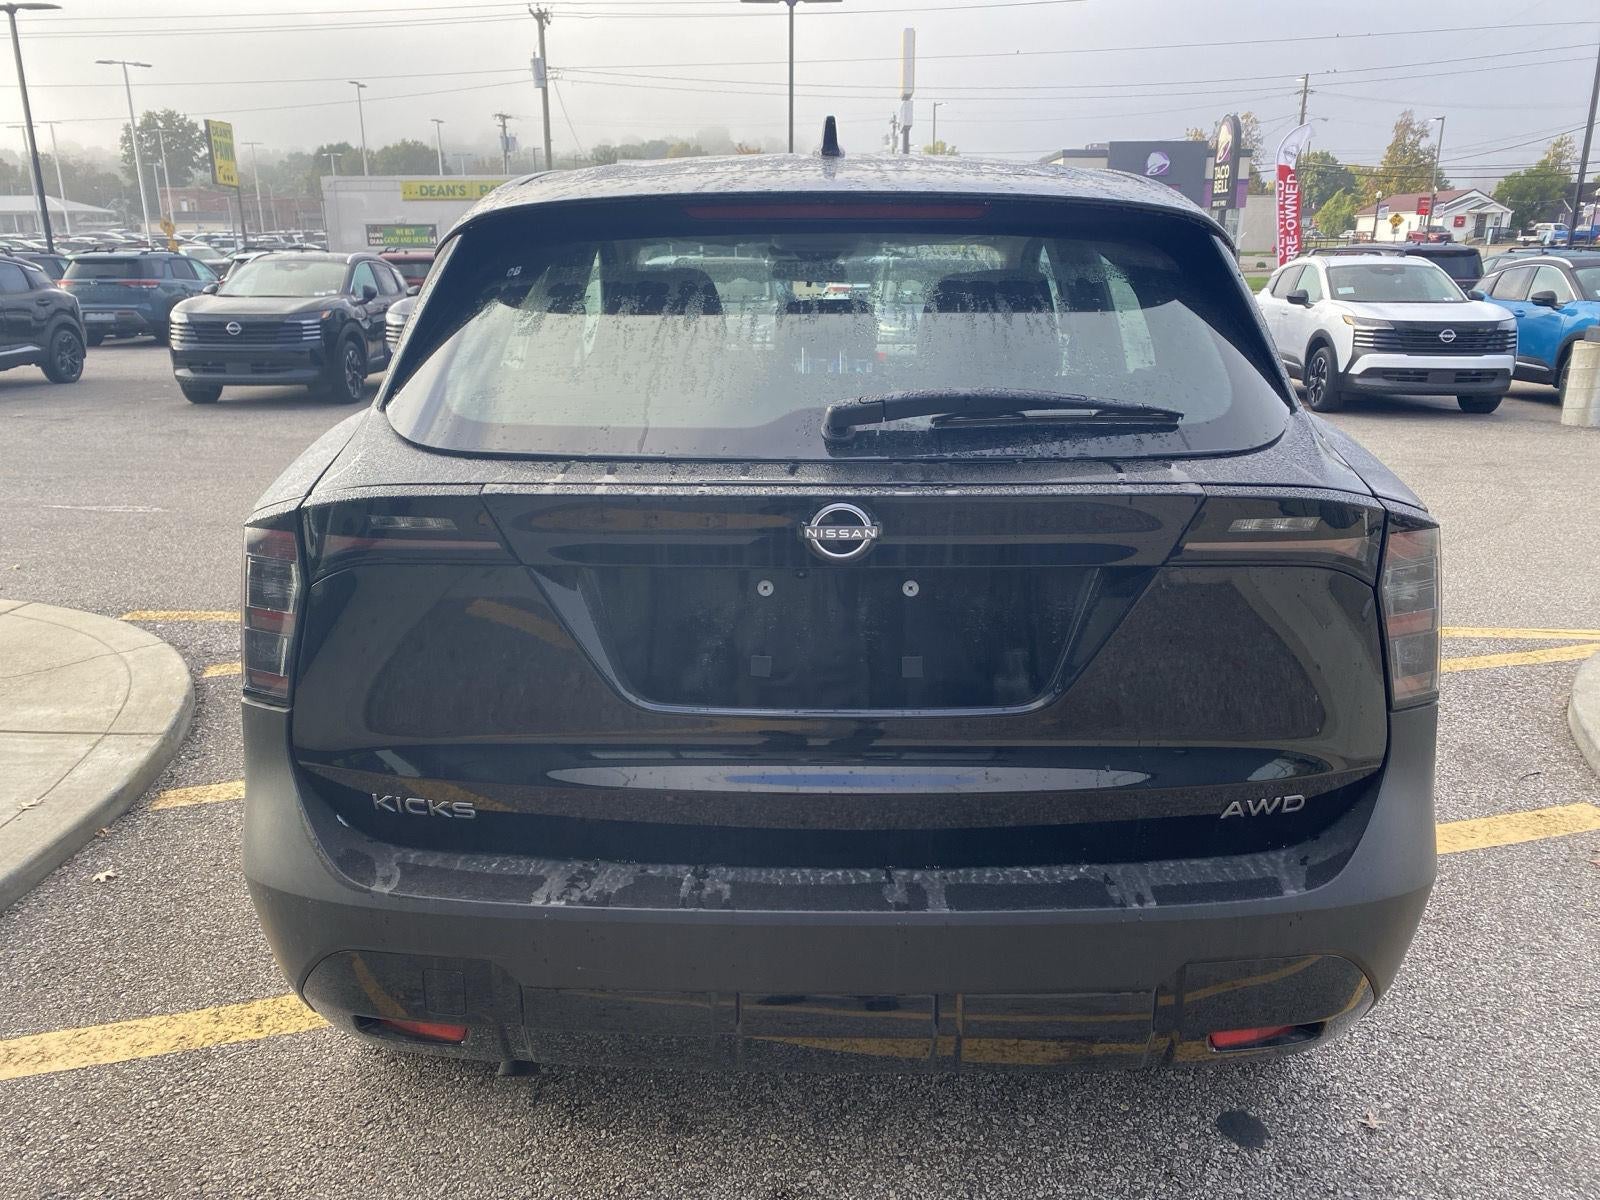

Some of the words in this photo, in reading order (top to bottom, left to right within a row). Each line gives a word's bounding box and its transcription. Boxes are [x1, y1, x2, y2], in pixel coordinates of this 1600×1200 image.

[1214, 164, 1230, 180] TACO
[419, 184, 467, 197] DEAN'S
[1213, 179, 1229, 194] BELL
[806, 529, 876, 538] NISSAN
[371, 793, 477, 819] KICKS
[1219, 794, 1306, 819] AWD
